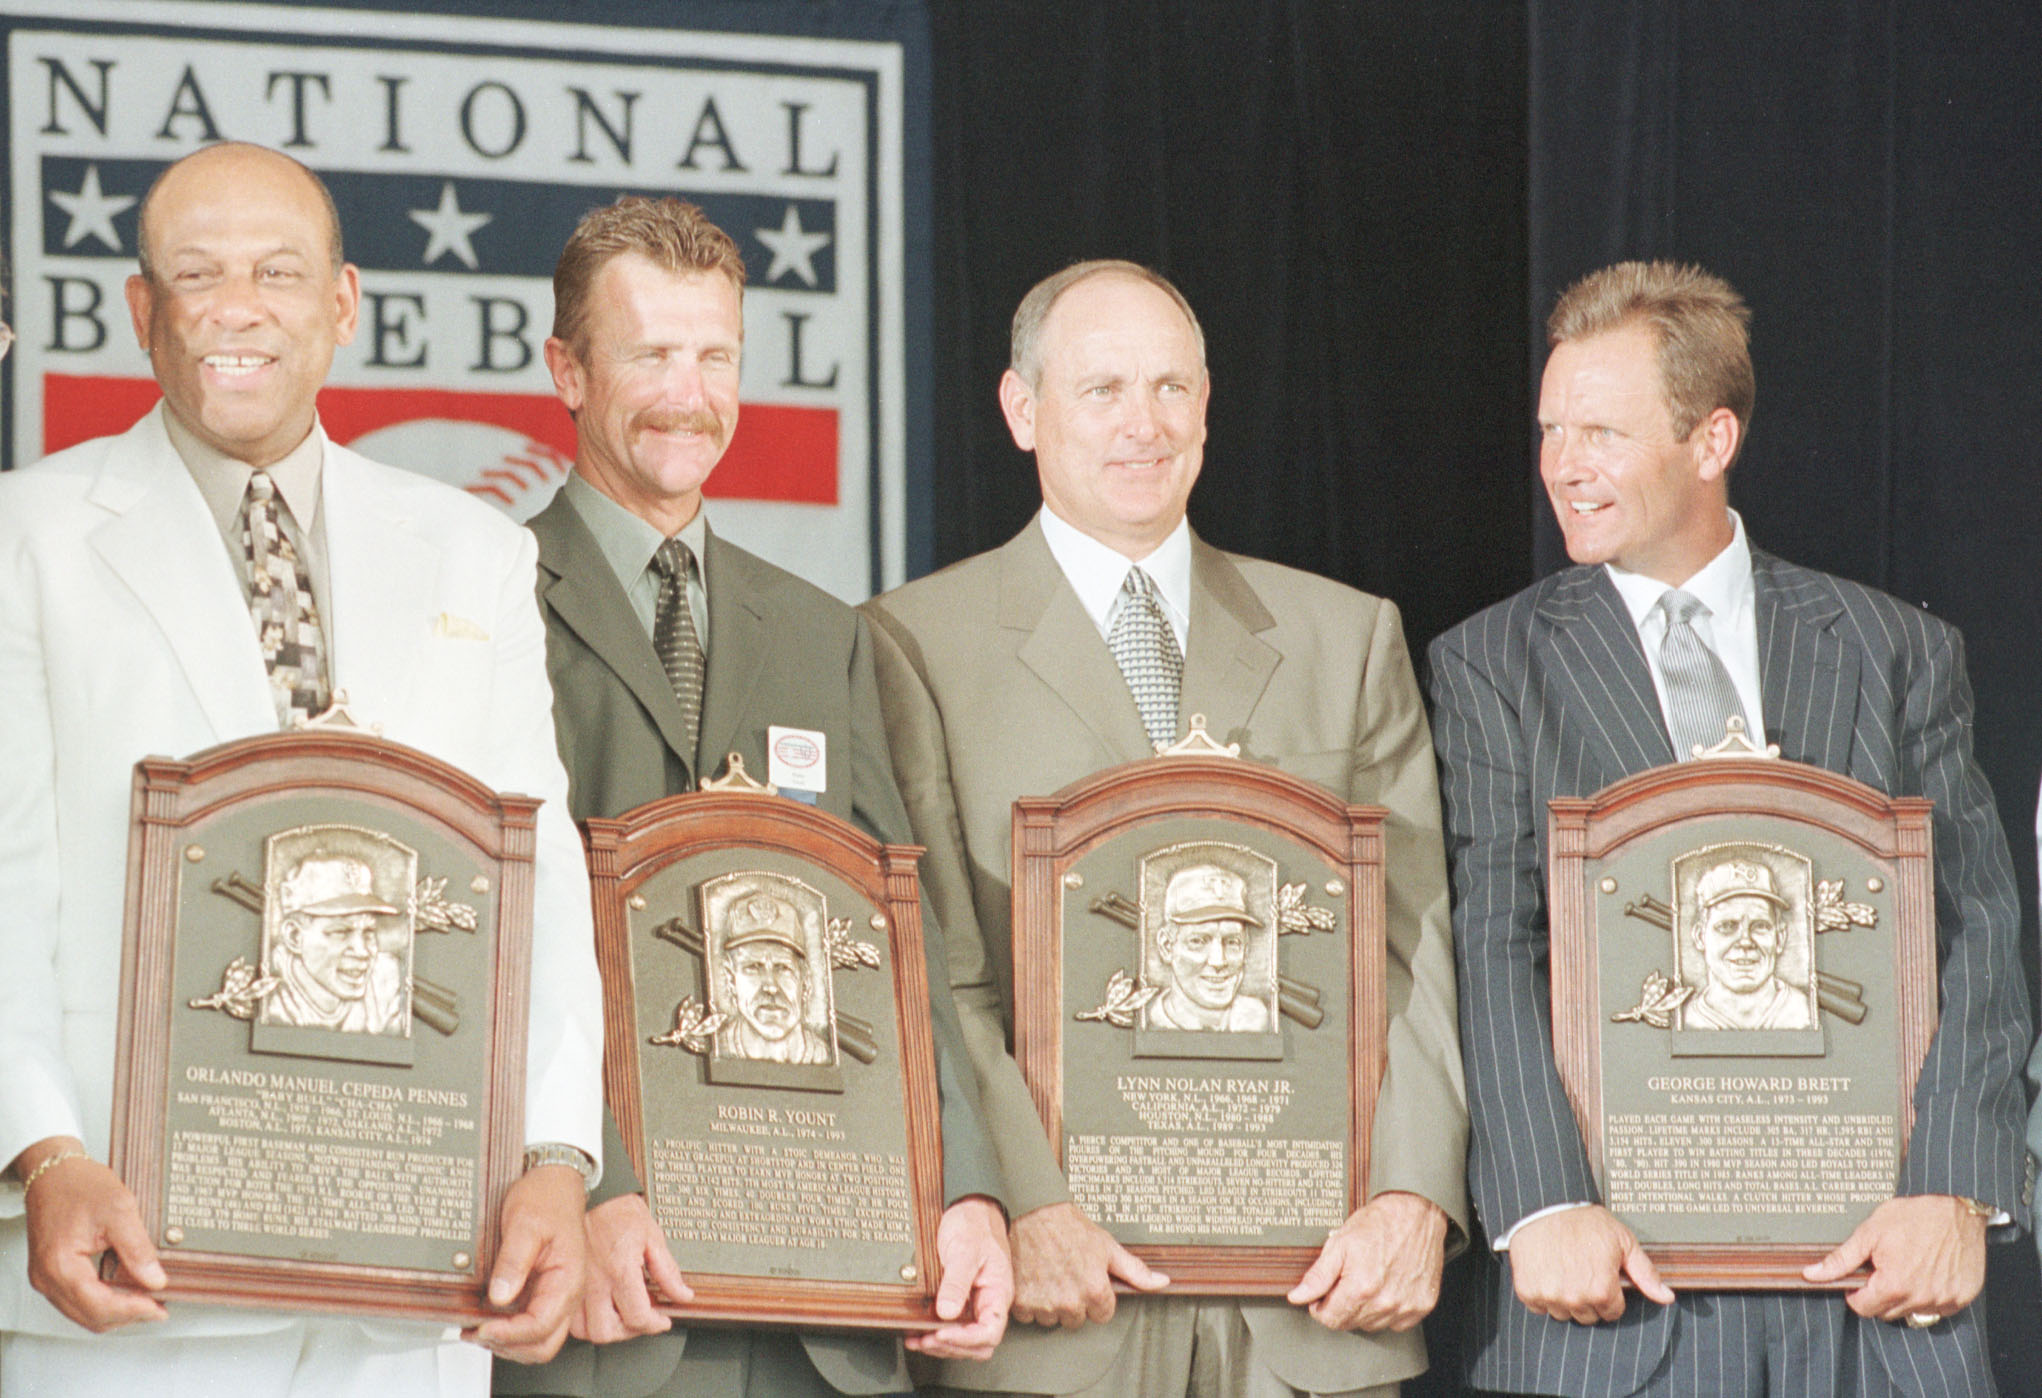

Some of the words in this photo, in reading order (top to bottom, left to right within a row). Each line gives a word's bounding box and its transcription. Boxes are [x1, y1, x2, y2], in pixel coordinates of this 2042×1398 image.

[38, 57, 839, 177] NATIONAL
[43, 275, 839, 388] BEBL
[185, 1065, 265, 1088] ORLANDO
[269, 1073, 337, 1096] MANUEL
[341, 1081, 403, 1102] CEPEDA
[407, 1087, 468, 1107] PENNES
[1117, 1076, 1160, 1090] LYNN
[1165, 1077, 1221, 1092] NOLAN
[1226, 1079, 1268, 1093] RYAN
[1273, 1079, 1294, 1093] JR.
[1647, 1077, 1715, 1090] GEORGE
[1720, 1076, 1792, 1090] HOWARD
[1797, 1076, 1851, 1090] BRETT
[1670, 1094, 1713, 1104] KANSAS
[1716, 1094, 1743, 1104] CITY,
[1773, 1094, 1794, 1104] 1973
[1807, 1094, 1828, 1104] 1993
[717, 1104, 763, 1121] ROBIN
[767, 1108, 781, 1123] R.
[784, 1109, 836, 1127] YOUNT
[1608, 1115, 1640, 1124] PLAYED
[1644, 1115, 1666, 1124] EACH
[1670, 1115, 1694, 1124] GAME
[1698, 1115, 1720, 1124] WITH
[1723, 1115, 1770, 1124] CEASELESS
[1774, 1115, 1818, 1124] INTENSITY
[1821, 1115, 1840, 1124] AND
[1843, 1115, 1893, 1124] UNBRIDLED
[709, 1121, 770, 1136] MILWAUKEE,
[796, 1127, 815, 1139] 1974
[825, 1129, 845, 1141] 1993
[1609, 1147, 1632, 1156] FIRST
[1637, 1147, 1668, 1157] PLAYER
[1673, 1147, 1684, 1157] TO
[1688, 1147, 1705, 1157] WIN
[1709, 1147, 1744, 1157] BATTING
[1749, 1147, 1777, 1157] TITLES
[1782, 1147, 1791, 1157] IN
[1796, 1147, 1822, 1157] THREE
[1827, 1147, 1866, 1157] DECADES
[1610, 1191, 1633, 1201] MOST
[1638, 1191, 1694, 1201] INTENTIONAL
[1743, 1192, 1776, 1201] CLUTCH
[1781, 1192, 1811, 1201] HITTER
[1815, 1192, 1846, 1202] WHOSE
[1611, 1203, 1646, 1212] RESPECT
[1649, 1203, 1665, 1212] FOR
[1668, 1203, 1684, 1212] THE
[1686, 1203, 1709, 1212] GAME
[1713, 1203, 1729, 1212] LED
[1732, 1203, 1742, 1212] TO
[1745, 1203, 1792, 1213] UNIVERSAL
